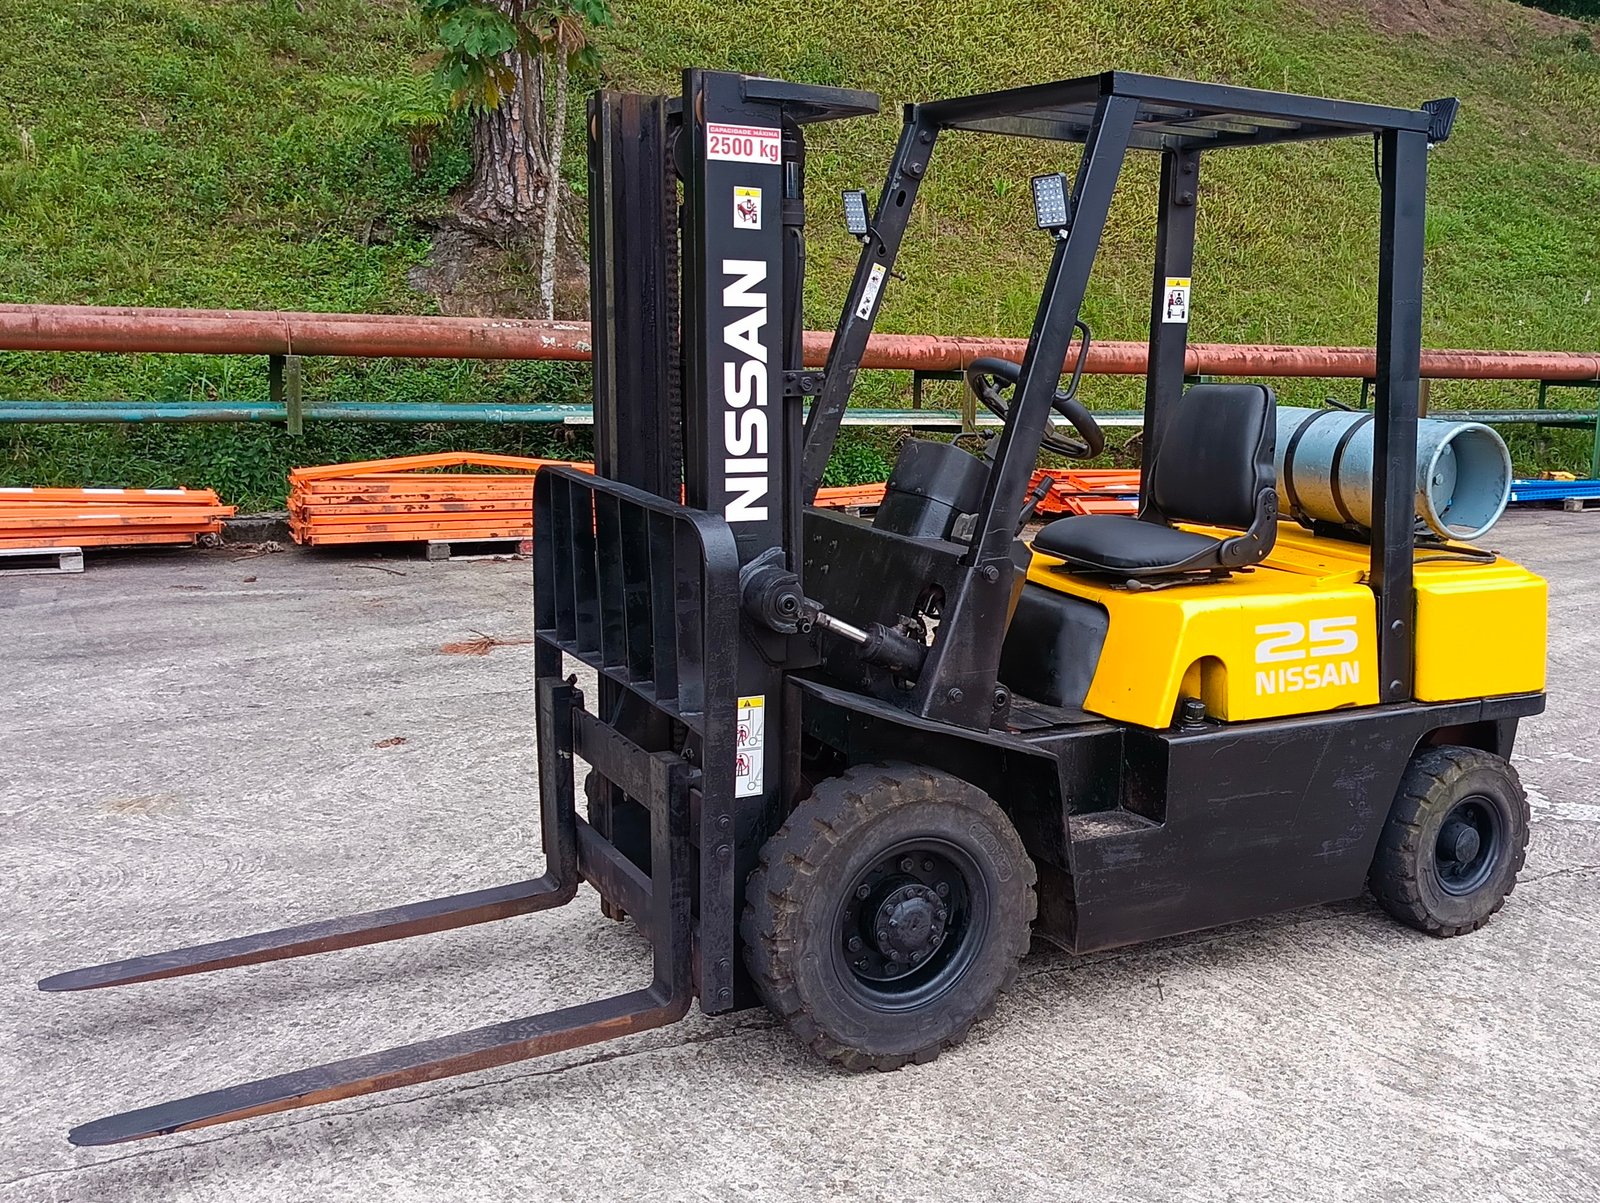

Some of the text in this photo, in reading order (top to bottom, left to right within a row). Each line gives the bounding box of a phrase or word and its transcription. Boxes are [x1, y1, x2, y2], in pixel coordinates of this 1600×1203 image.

[710, 127, 752, 135] CAPACIDADE
[710, 136, 778, 162] 2500 kg
[722, 259, 768, 522] NISSAN
[1255, 615, 1358, 664] 25
[1255, 660, 1359, 696] NISSAN
